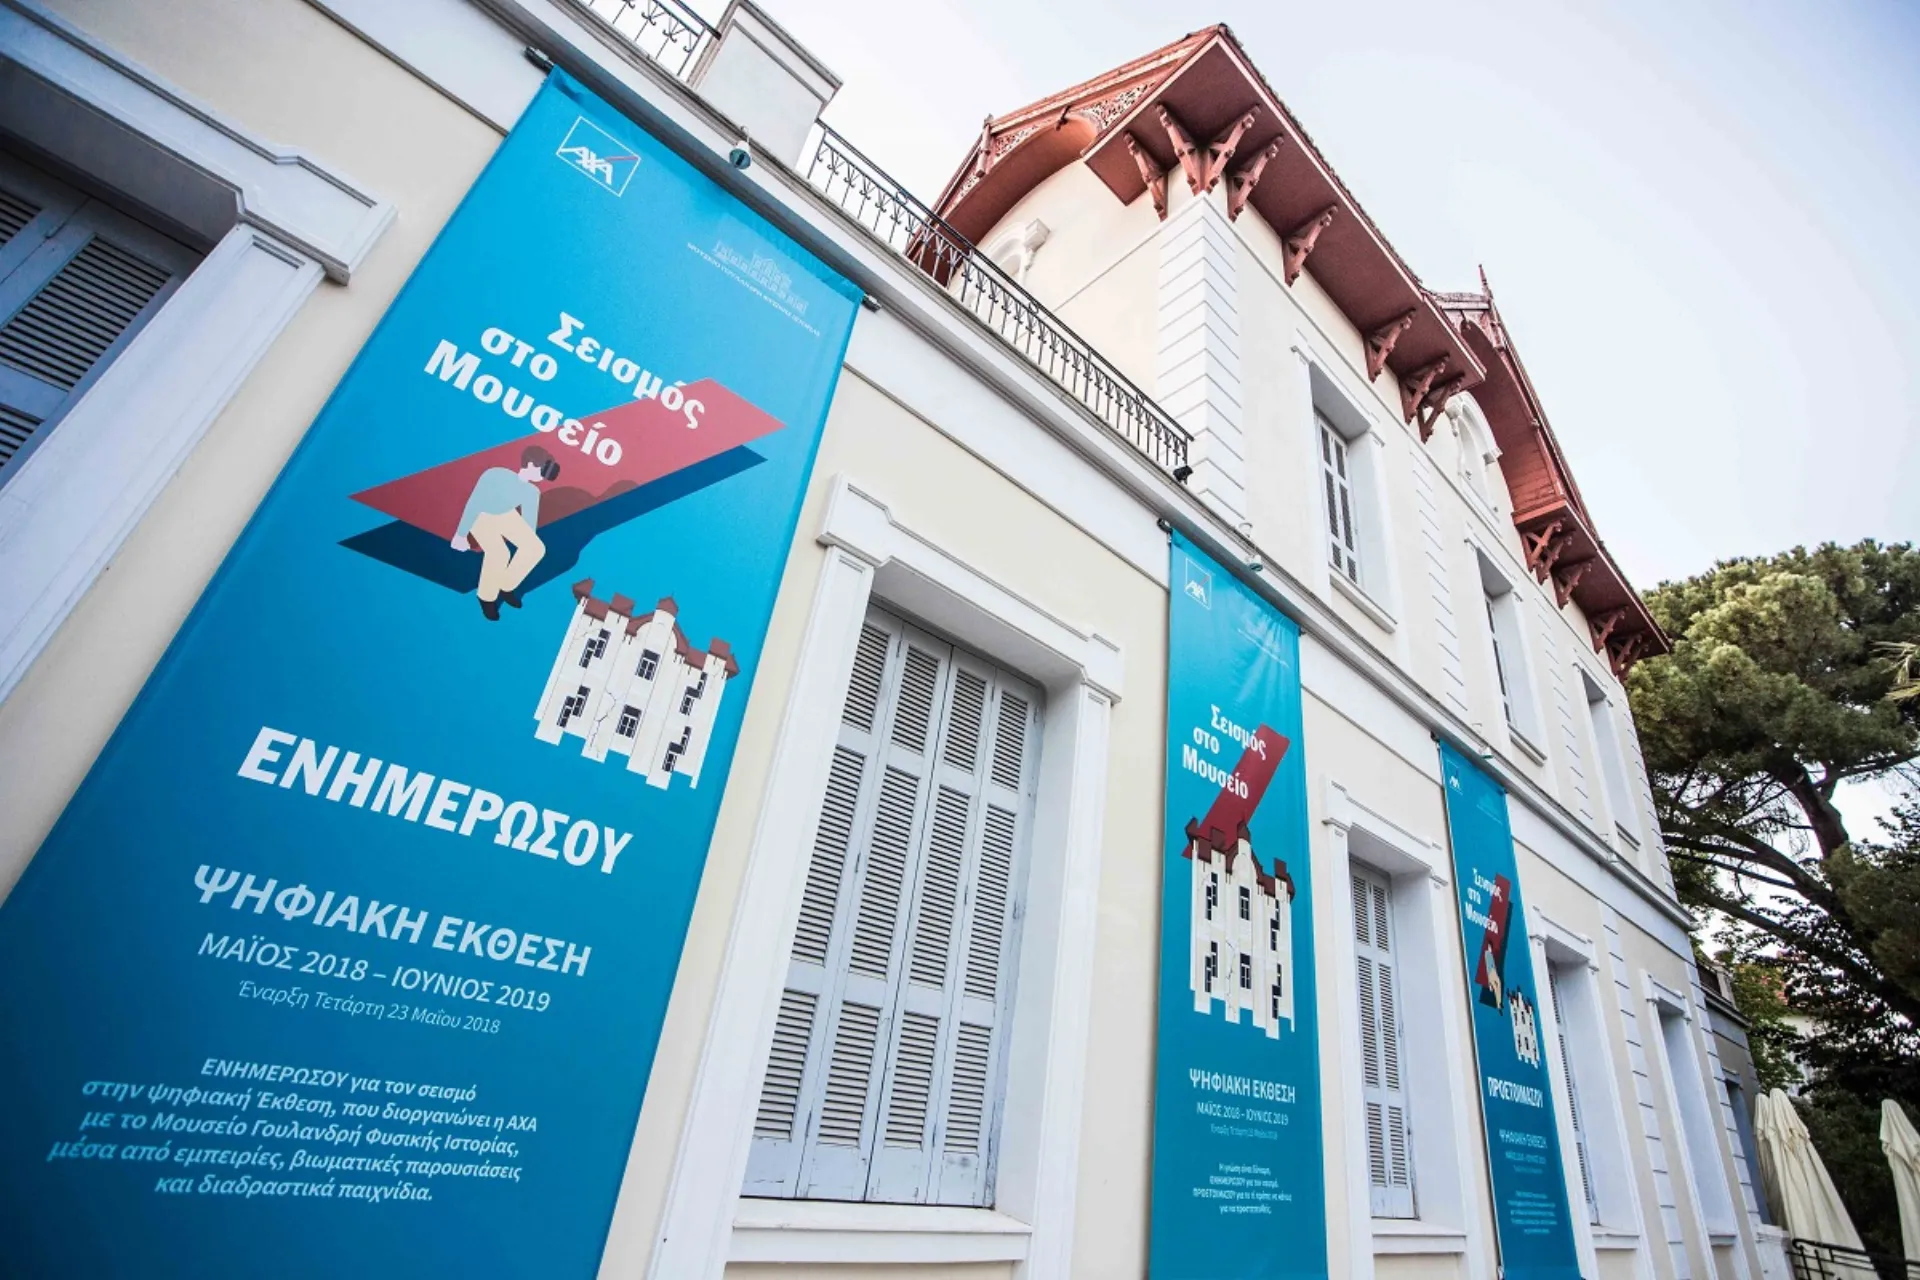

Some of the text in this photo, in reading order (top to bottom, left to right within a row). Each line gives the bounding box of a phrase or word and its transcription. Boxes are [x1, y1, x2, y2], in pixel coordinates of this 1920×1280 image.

[480, 327, 558, 381] στο
[547, 311, 705, 429] Σεισμός
[423, 338, 622, 466] Μουσείο
[1193, 727, 1220, 754] στο
[1210, 704, 1267, 760] Σεισμός
[1182, 744, 1248, 799] Μουσείο
[237, 726, 633, 875] ΕΝΗΜΕΡΩΣΟΥ
[194, 864, 592, 976] ΨΗΦΙΑΚΗ ΕΚΘΕΣΗ
[198, 932, 300, 970] ΜΑΪΟΣ
[300, 950, 369, 981] 2018
[391, 965, 494, 1003] ΙΟΥΝΙΟΣ
[495, 984, 551, 1012] 2019
[238, 980, 310, 1009] Έναρξη
[314, 991, 384, 1020] Τετάρτη
[387, 1003, 409, 1021] 23
[463, 1015, 501, 1034] 2018
[82, 1080, 145, 1102] στην
[148, 1083, 252, 1112] ψηφιακή
[256, 1091, 337, 1118] Έκθεση,
[342, 1102, 379, 1119] που
[382, 1103, 491, 1129] διοργανώνει
[493, 1116, 504, 1131] η
[200, 1058, 477, 1104] ΕΝΗΜΕΡΩΣΟΥ για τον σεισμό
[1189, 1067, 1296, 1104] ΨΗΦΙΑΚΗ ΕΚΘΕΣΗ
[46, 1135, 522, 1183] μέσα από εμπειρίες, βιωματικές παρουσιάσεις
[79, 1111, 519, 1157] με το Μουσείο Γουλανδρή Φυσικής Ιστορίας,
[154, 1174, 433, 1203] και διαδραστικά παιχνίδια.
